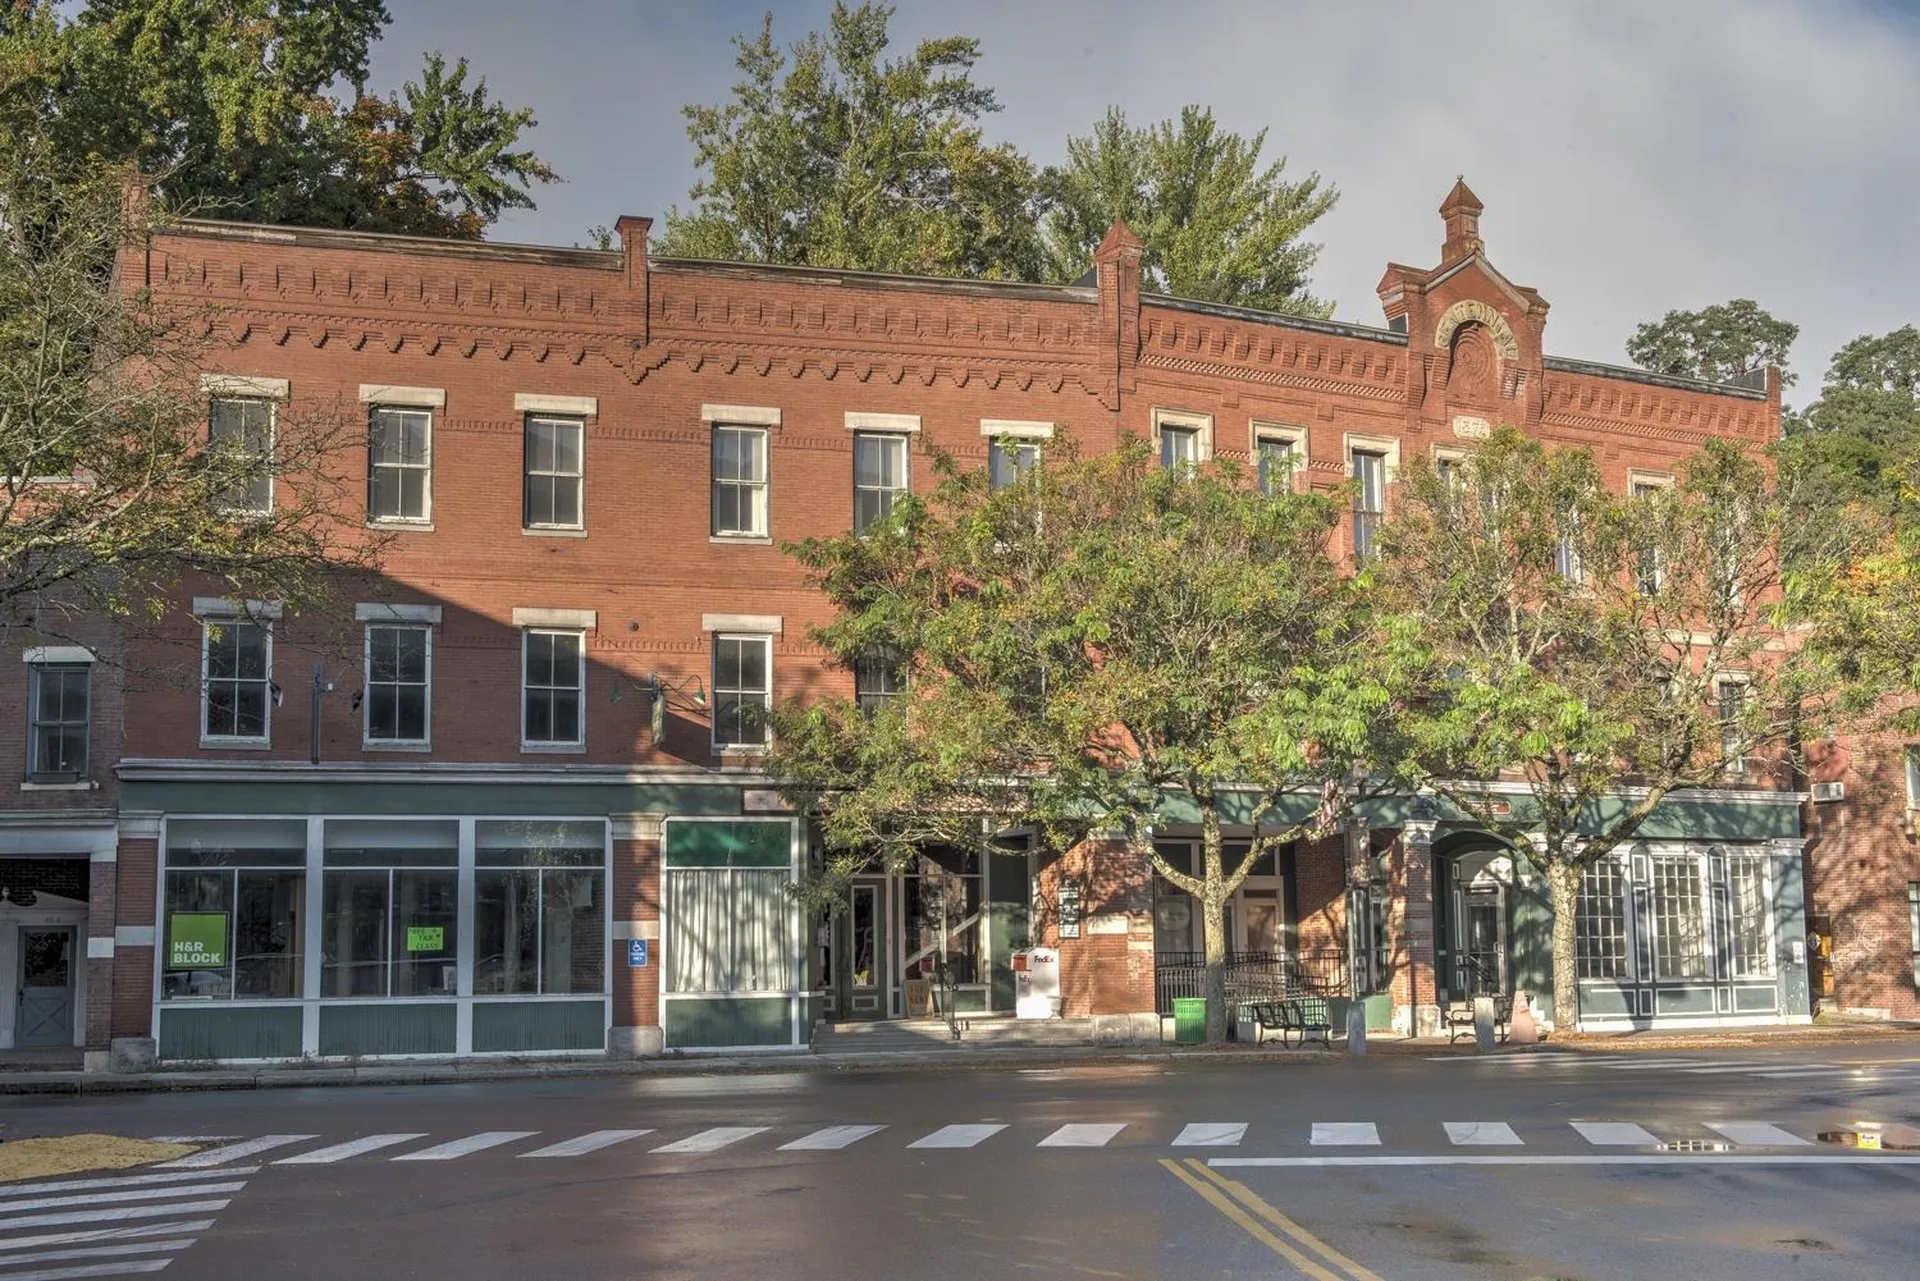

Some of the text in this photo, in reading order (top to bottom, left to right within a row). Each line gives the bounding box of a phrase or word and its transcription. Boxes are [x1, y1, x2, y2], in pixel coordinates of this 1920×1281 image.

[174, 942, 203, 951] H&R
[173, 953, 220, 963] BLOCK
[1034, 955, 1054, 963] FedEx
